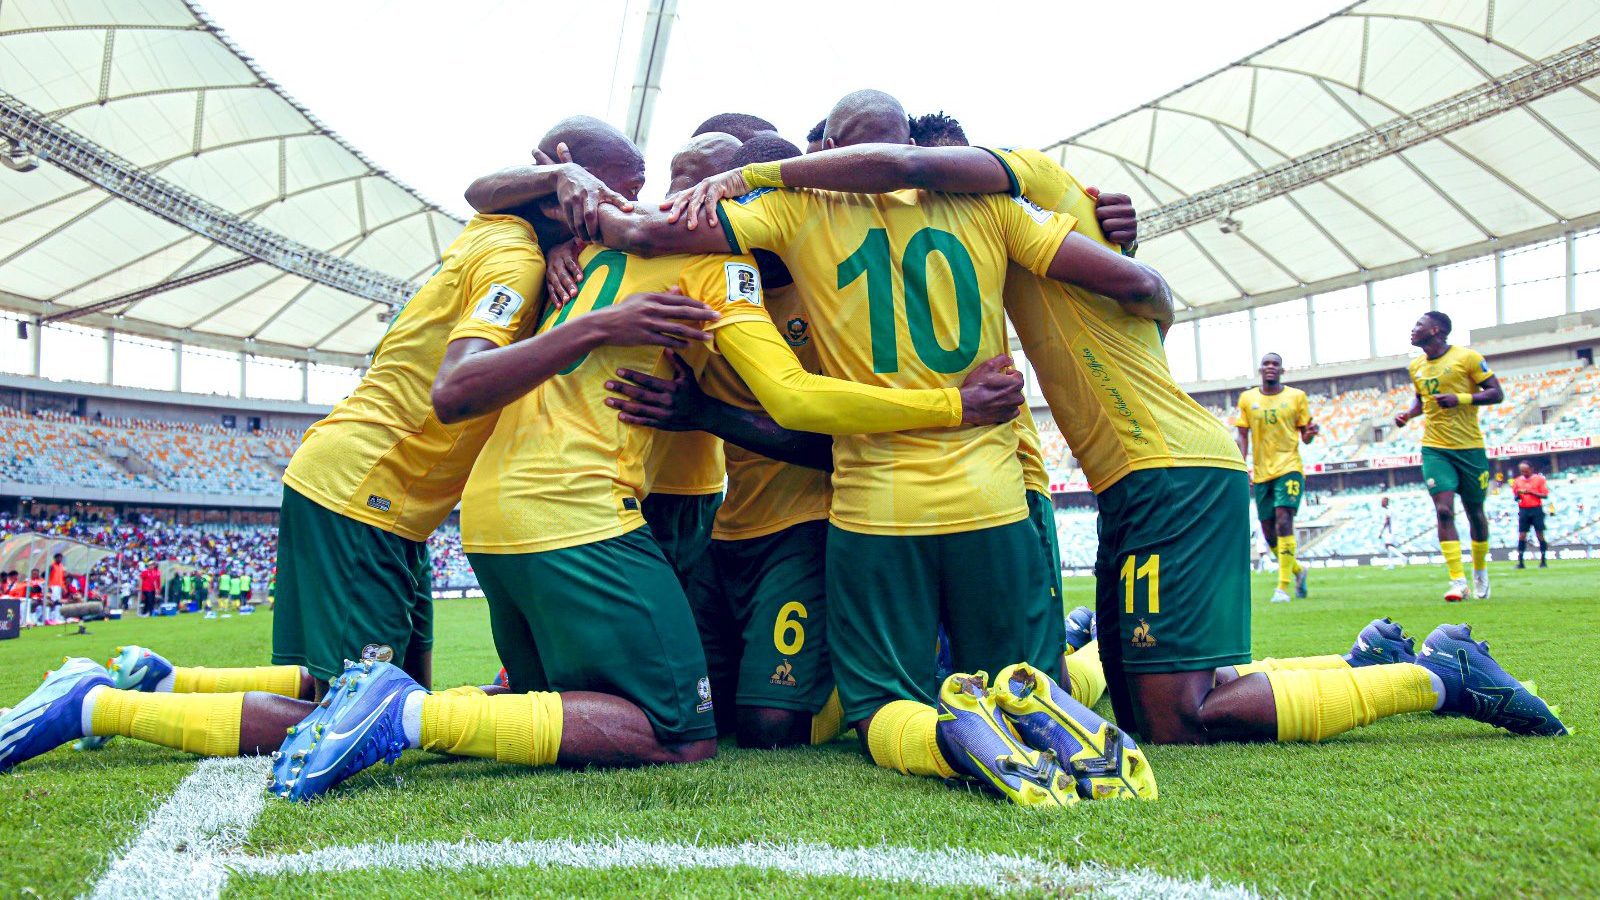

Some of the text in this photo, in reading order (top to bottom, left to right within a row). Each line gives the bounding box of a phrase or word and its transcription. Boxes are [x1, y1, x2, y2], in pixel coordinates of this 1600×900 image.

[535, 250, 628, 375] 0
[837, 226, 982, 375] 10
[1424, 378, 1441, 395] 12
[1264, 409, 1278, 425] 13
[1285, 480, 1300, 496] 13
[1120, 554, 1160, 614] 11
[774, 601, 808, 656] 6
